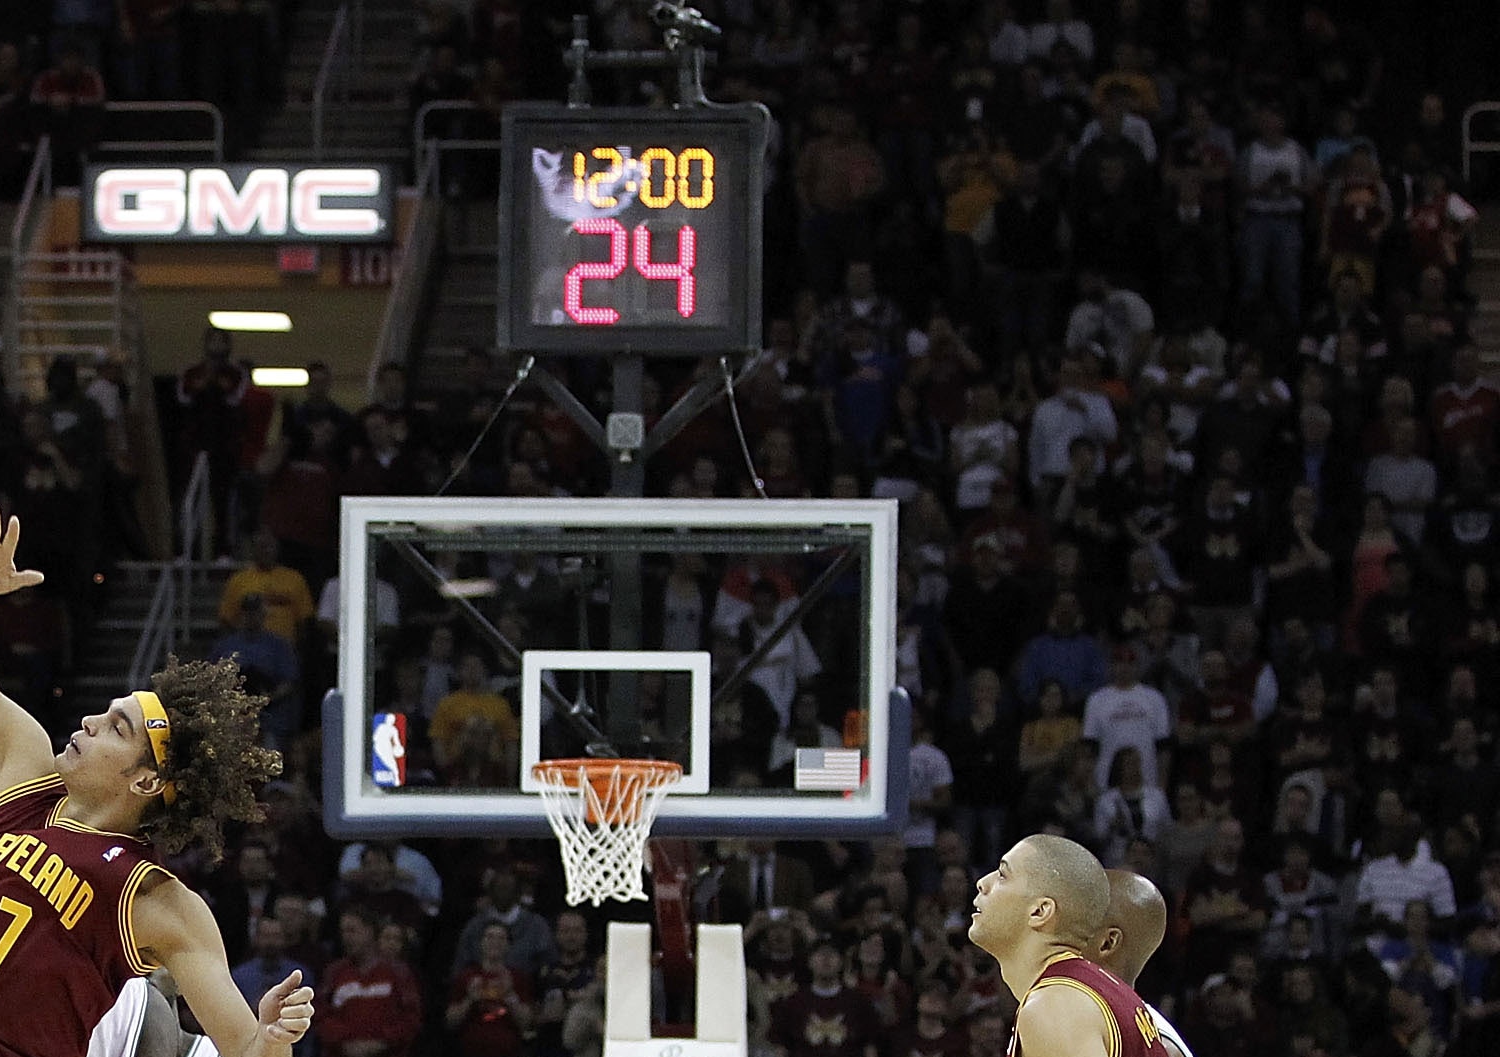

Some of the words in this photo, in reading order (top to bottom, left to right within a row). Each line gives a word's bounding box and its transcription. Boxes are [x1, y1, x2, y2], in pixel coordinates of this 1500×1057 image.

[94, 168, 381, 235] GMC
[573, 147, 715, 209] 12:00
[564, 218, 697, 324] 24
